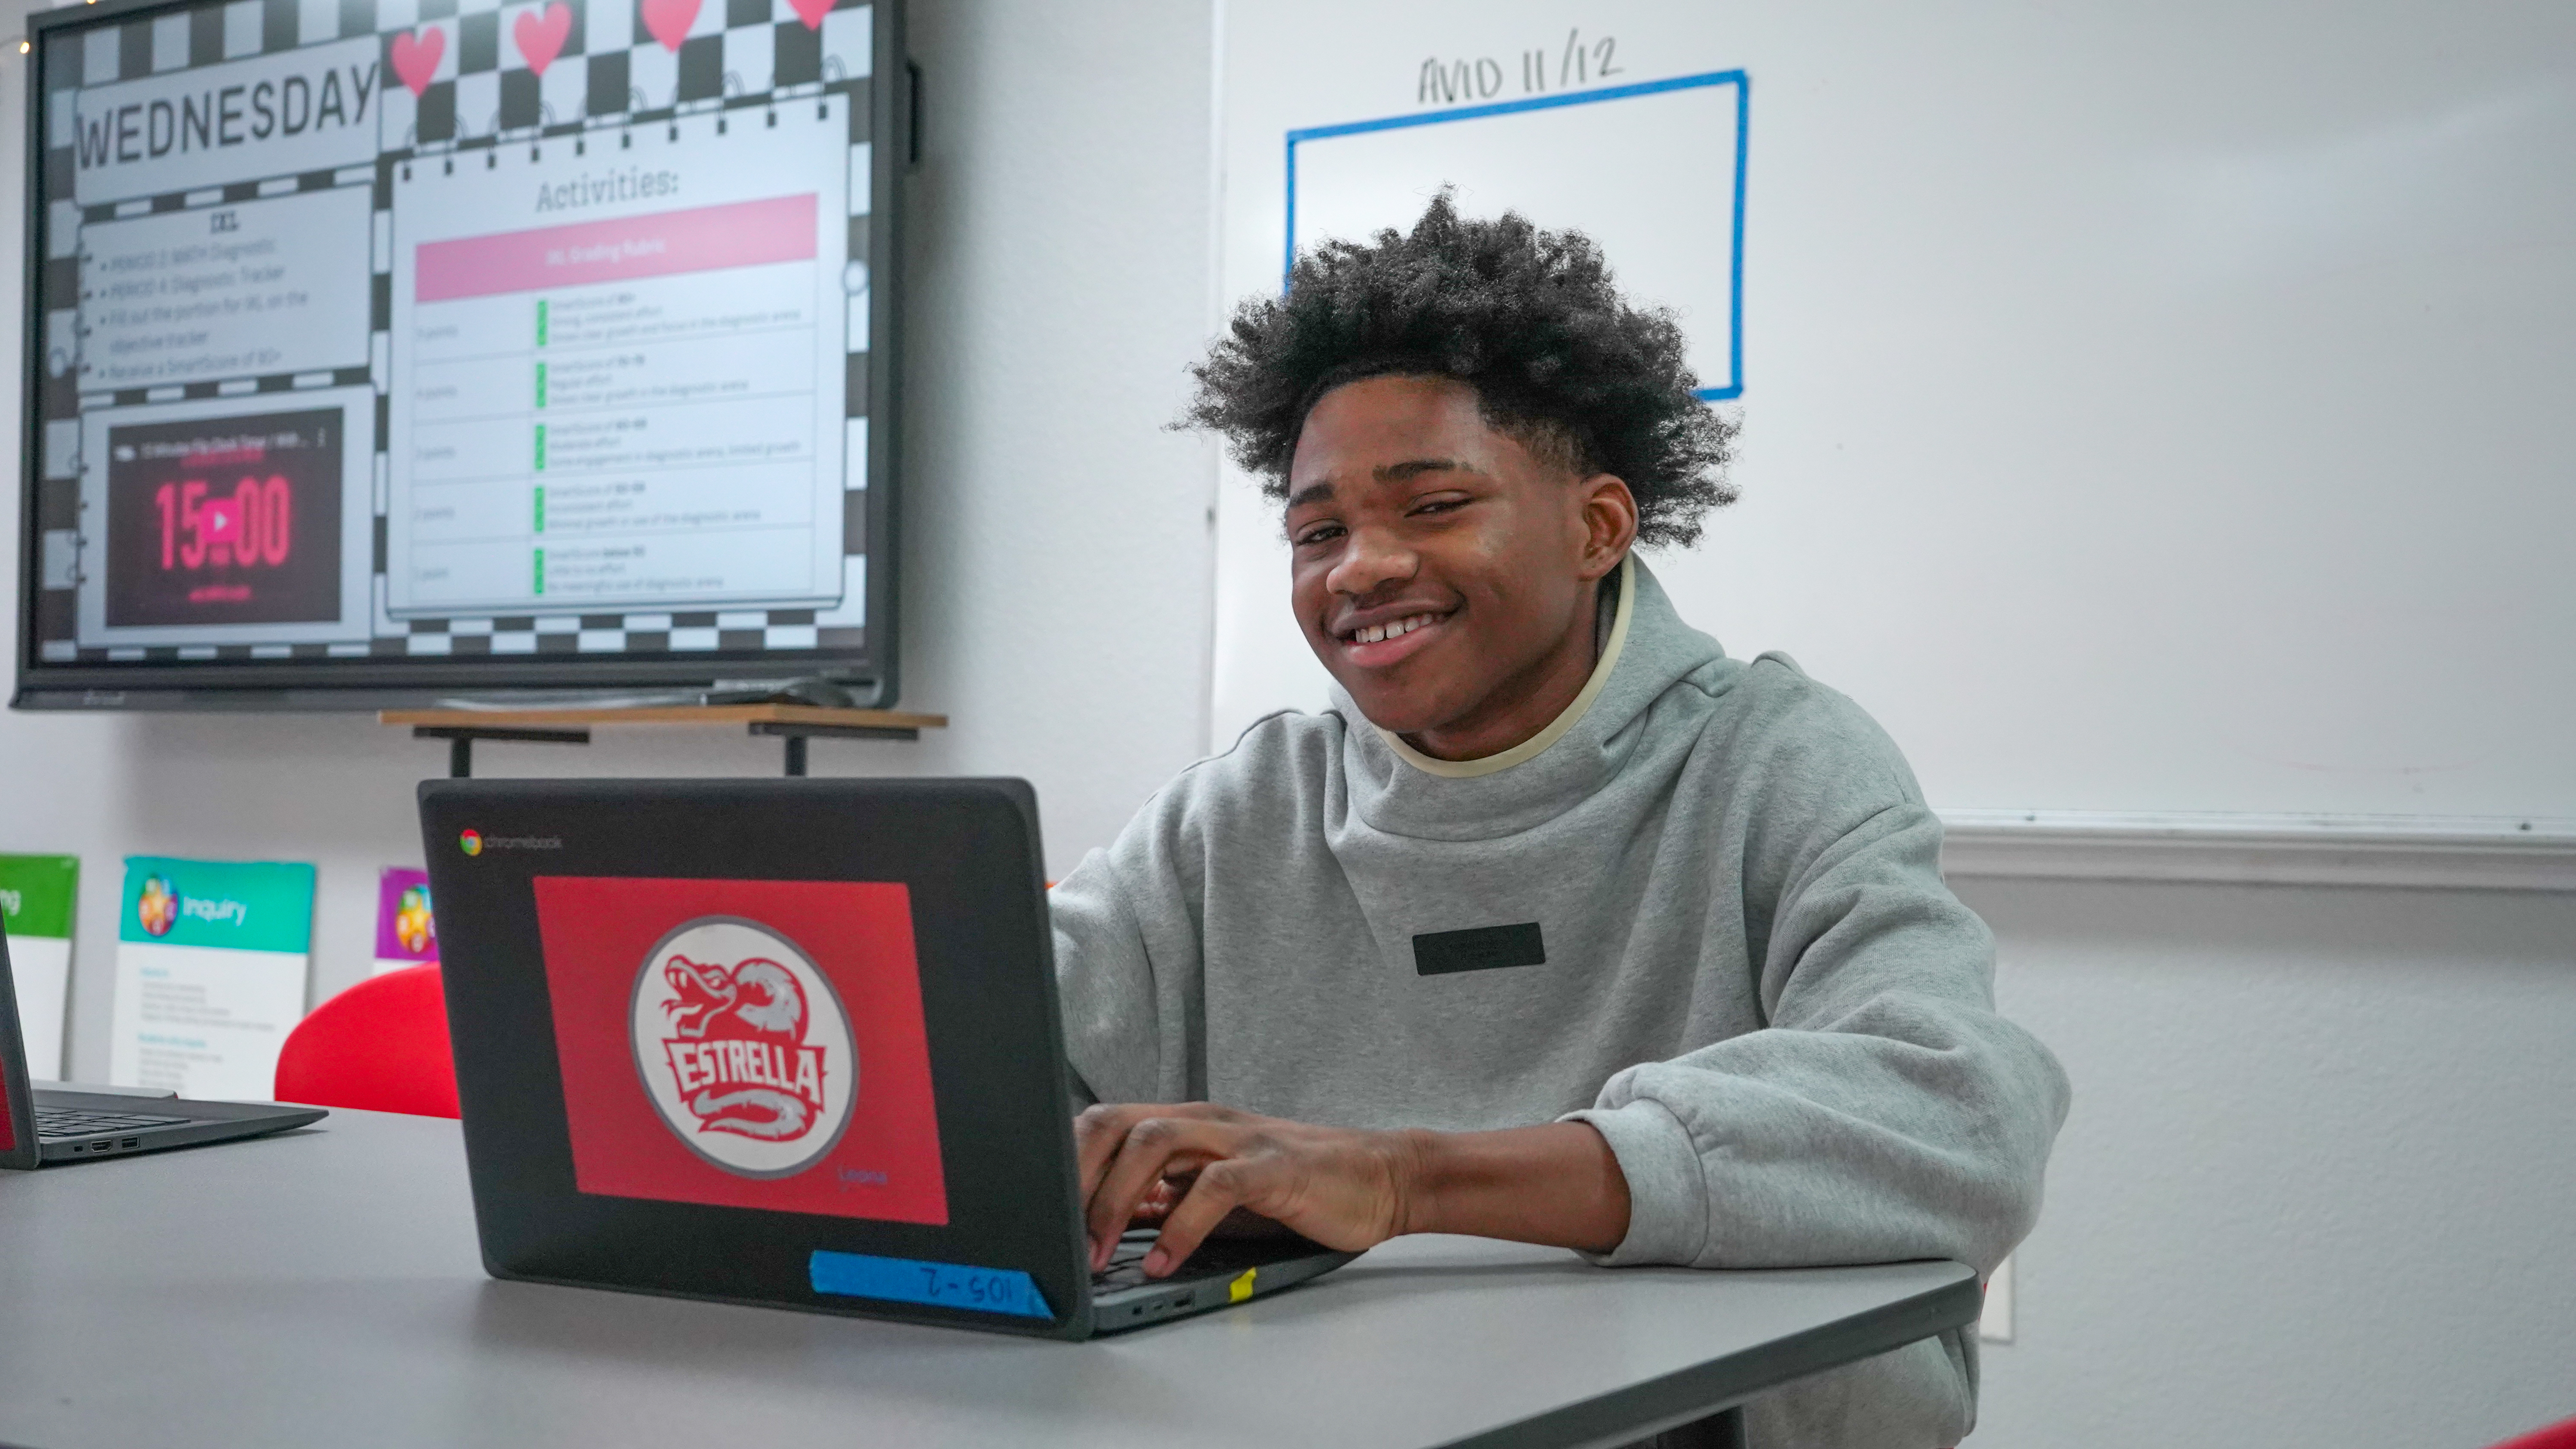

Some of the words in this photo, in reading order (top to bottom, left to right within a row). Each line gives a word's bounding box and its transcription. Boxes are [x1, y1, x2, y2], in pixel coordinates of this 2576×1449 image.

[1418, 55, 1503, 103] AVID
[76, 61, 380, 170] WEDNESDAY
[535, 166, 680, 213] Activities:
[210, 211, 239, 234] IXL
[209, 235, 275, 263] Diagnostic
[571, 243, 620, 267] Grading
[623, 237, 665, 258] Rubric
[171, 268, 235, 295] Diagnostic
[240, 261, 285, 283] Tracker
[130, 307, 148, 324] out
[152, 304, 171, 321] the
[174, 298, 219, 322] portion
[223, 296, 240, 313] for
[287, 288, 308, 306] the
[718, 312, 768, 329] diagnostic
[167, 351, 238, 373] SmartScore
[668, 382, 716, 398] diagnostic
[645, 448, 693, 463] diagnostic
[681, 512, 729, 526] diagnostic
[484, 834, 562, 850] chromebook
[667, 1040, 822, 1106] ESTRELLA
